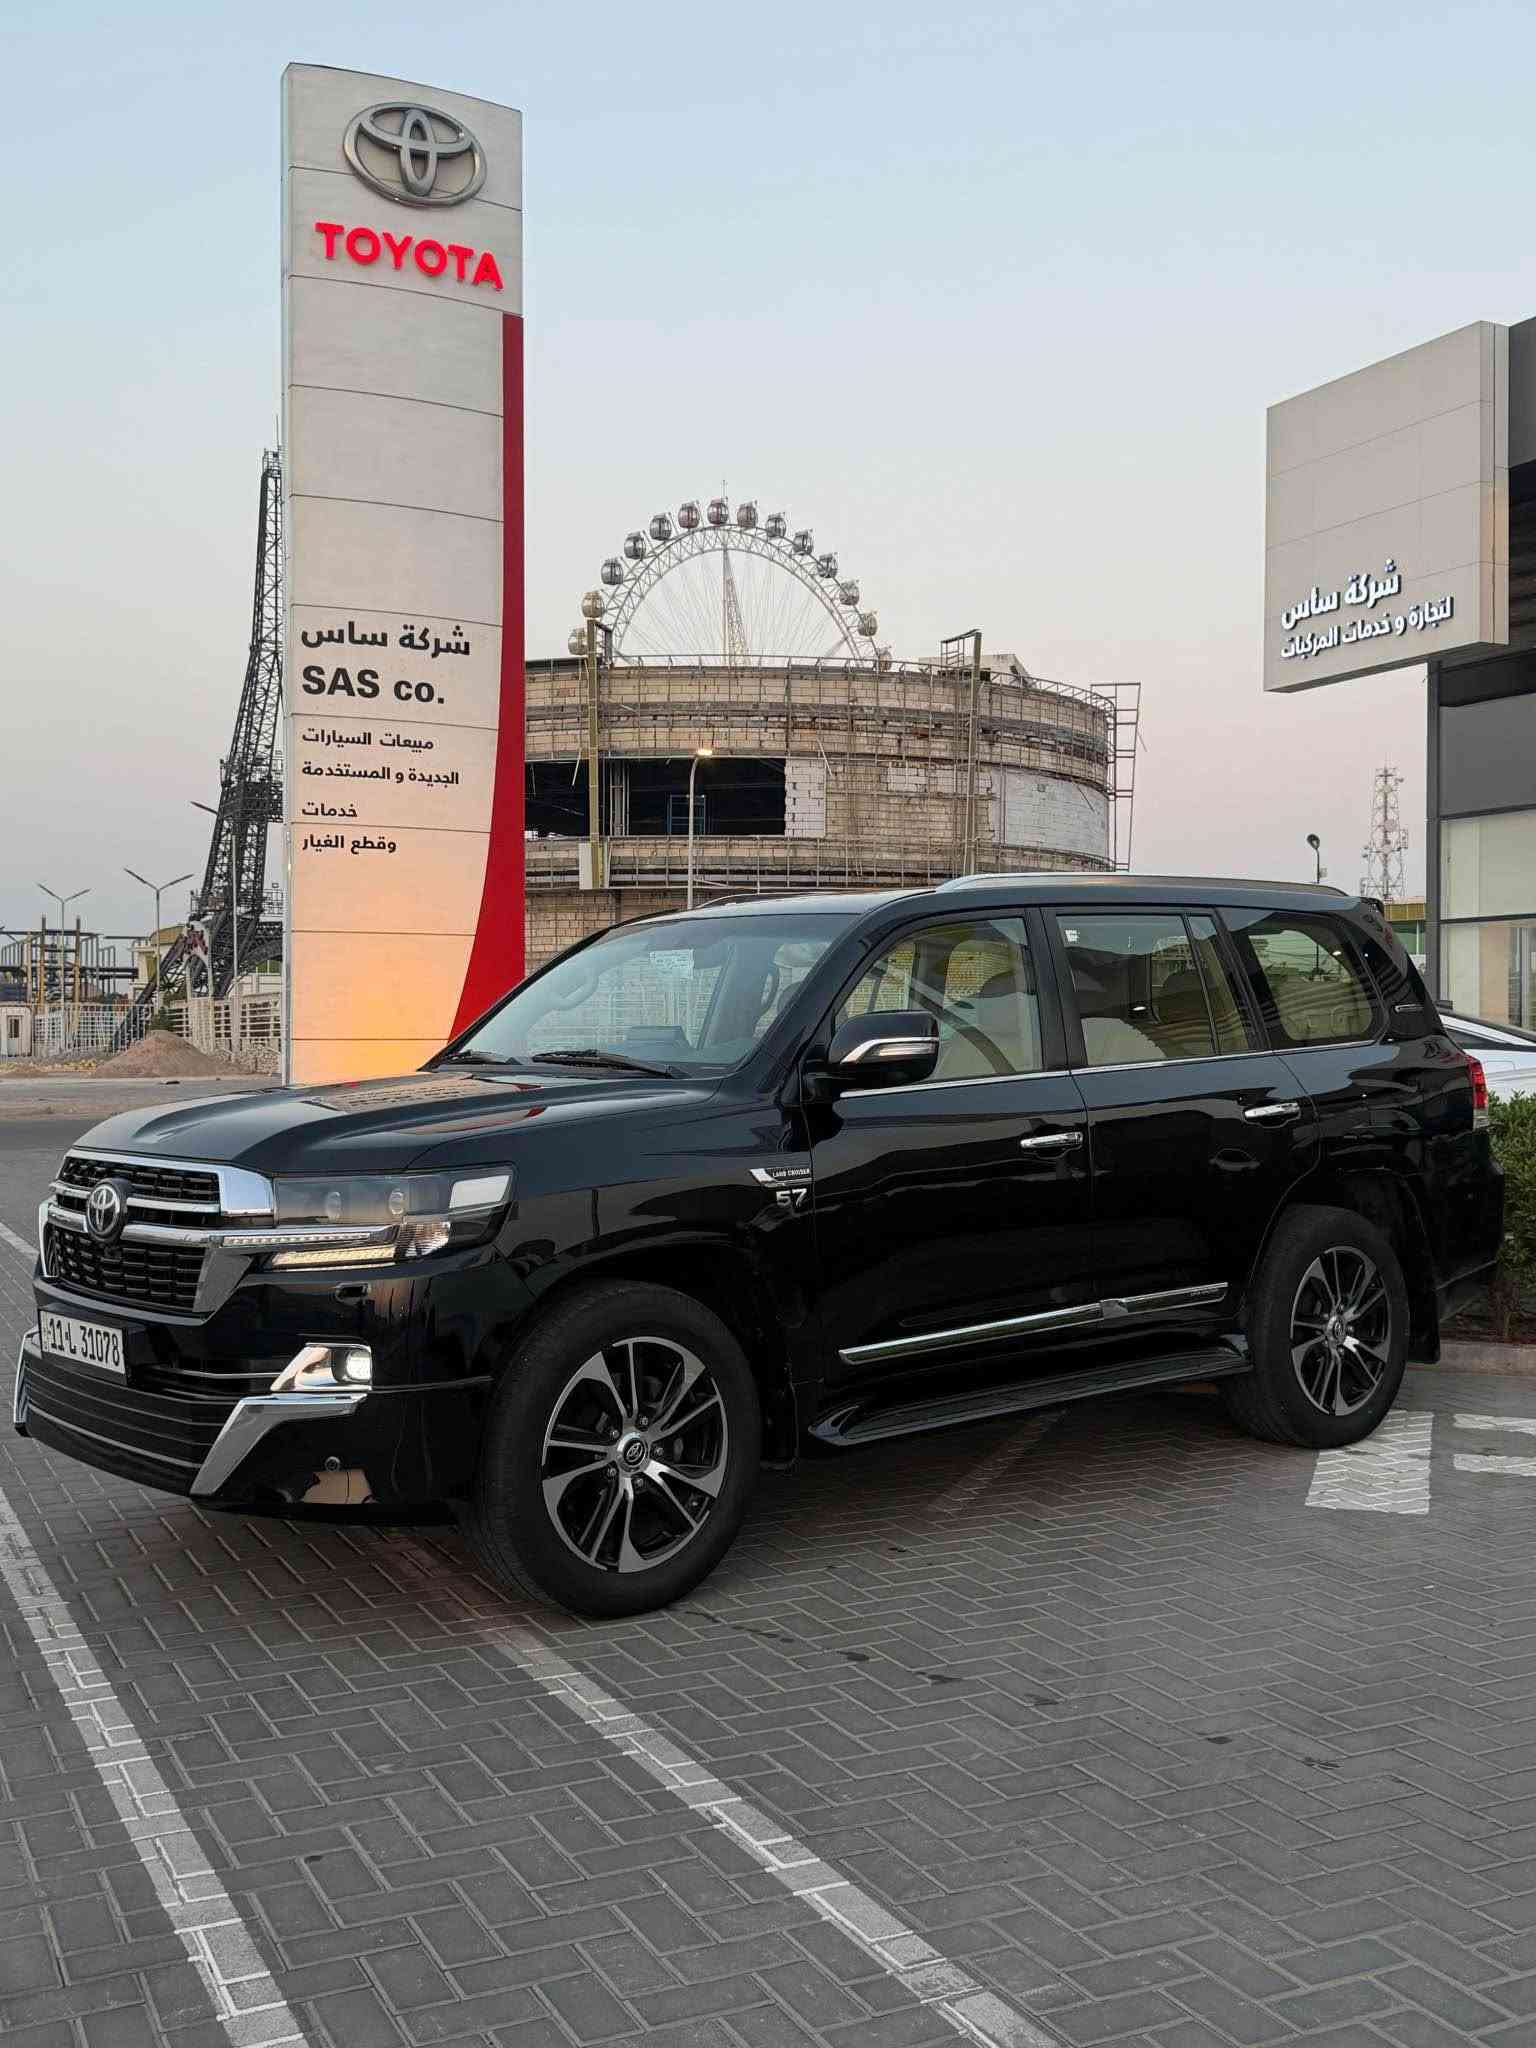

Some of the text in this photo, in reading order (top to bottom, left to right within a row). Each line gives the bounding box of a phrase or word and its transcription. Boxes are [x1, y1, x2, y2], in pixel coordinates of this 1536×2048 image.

[315, 222, 504, 291] TOYOTA
[1281, 558, 1401, 630] شركة ساس
[301, 621, 470, 658] شركة ساس
[1342, 613, 1393, 644] خدمات
[1394, 615, 1407, 636] و
[1281, 625, 1341, 659] المركبات
[302, 665, 444, 704] SAS co.
[302, 728, 434, 753] مبيعات السيارات
[302, 761, 460, 788] الجديدة و المستخدمة
[302, 802, 358, 818] خدمات
[302, 834, 397, 854] وقطع الغيار
[80, 1325, 120, 1367] 31078
